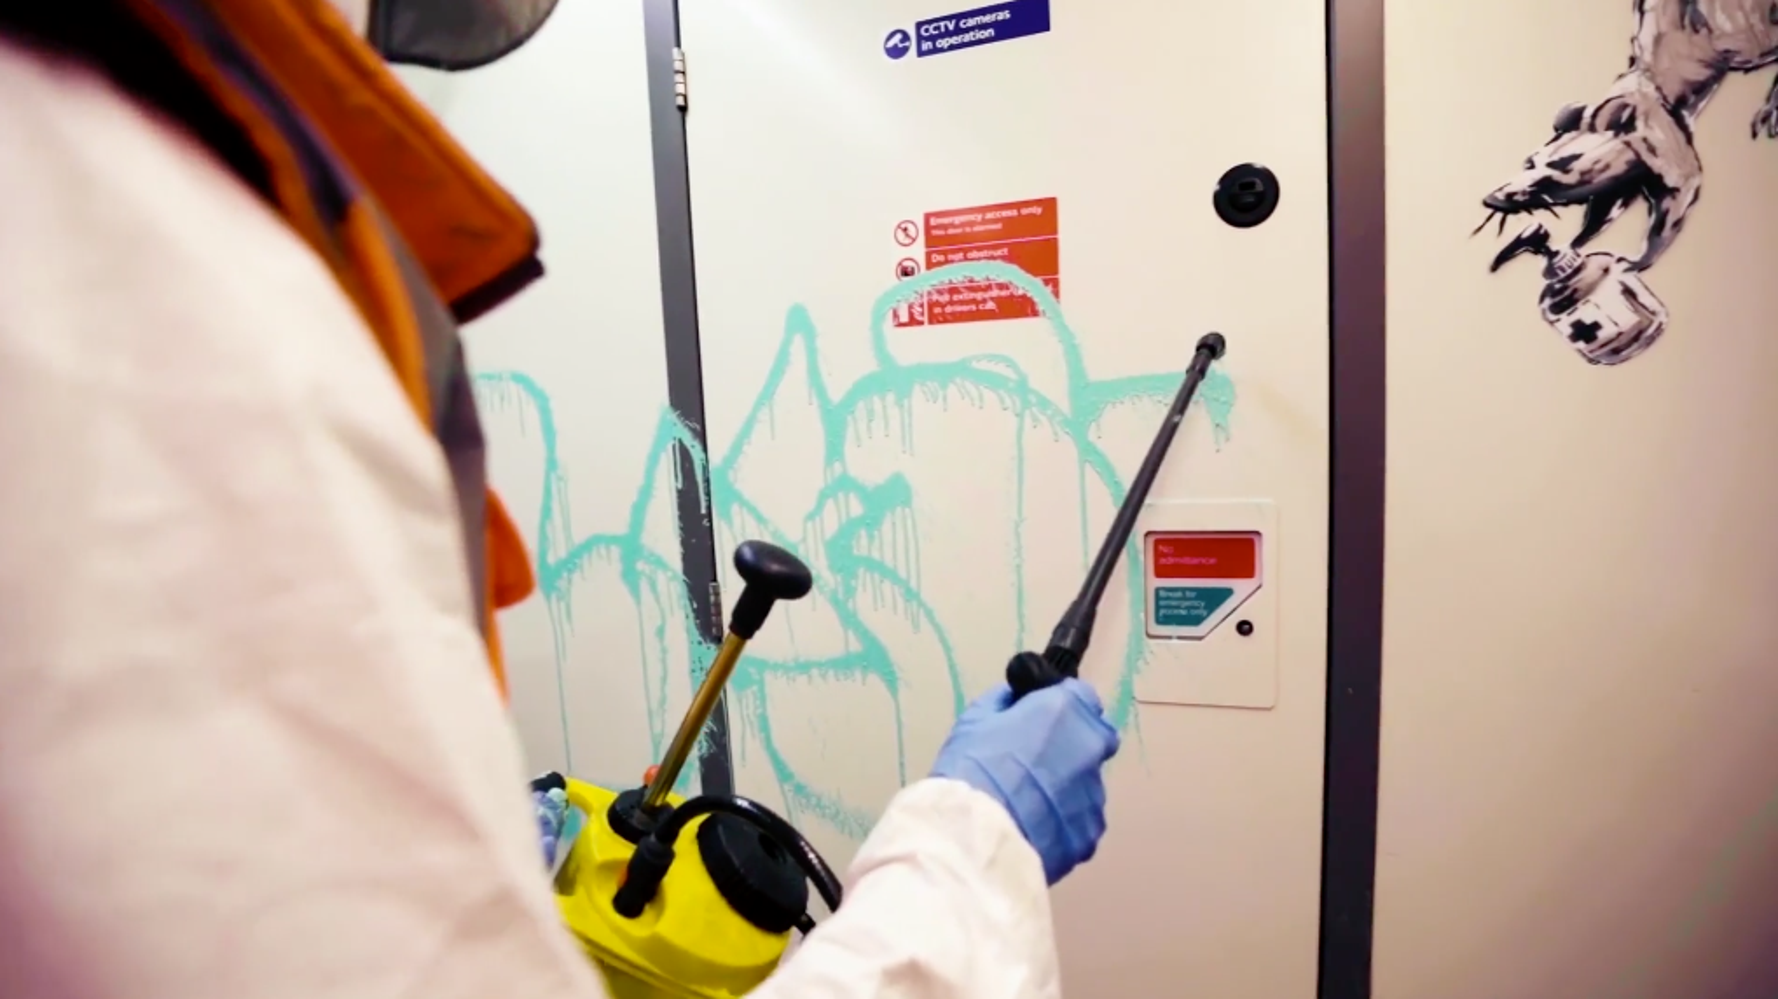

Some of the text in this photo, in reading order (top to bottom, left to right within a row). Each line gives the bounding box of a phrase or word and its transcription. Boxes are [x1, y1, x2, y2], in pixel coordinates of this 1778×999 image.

[920, 10, 1011, 37] CCTV cameras
[921, 27, 995, 52] in operation
[930, 205, 1043, 226] Emergency access only
[931, 247, 1009, 263] Do not obstruct
[933, 306, 942, 314] in
